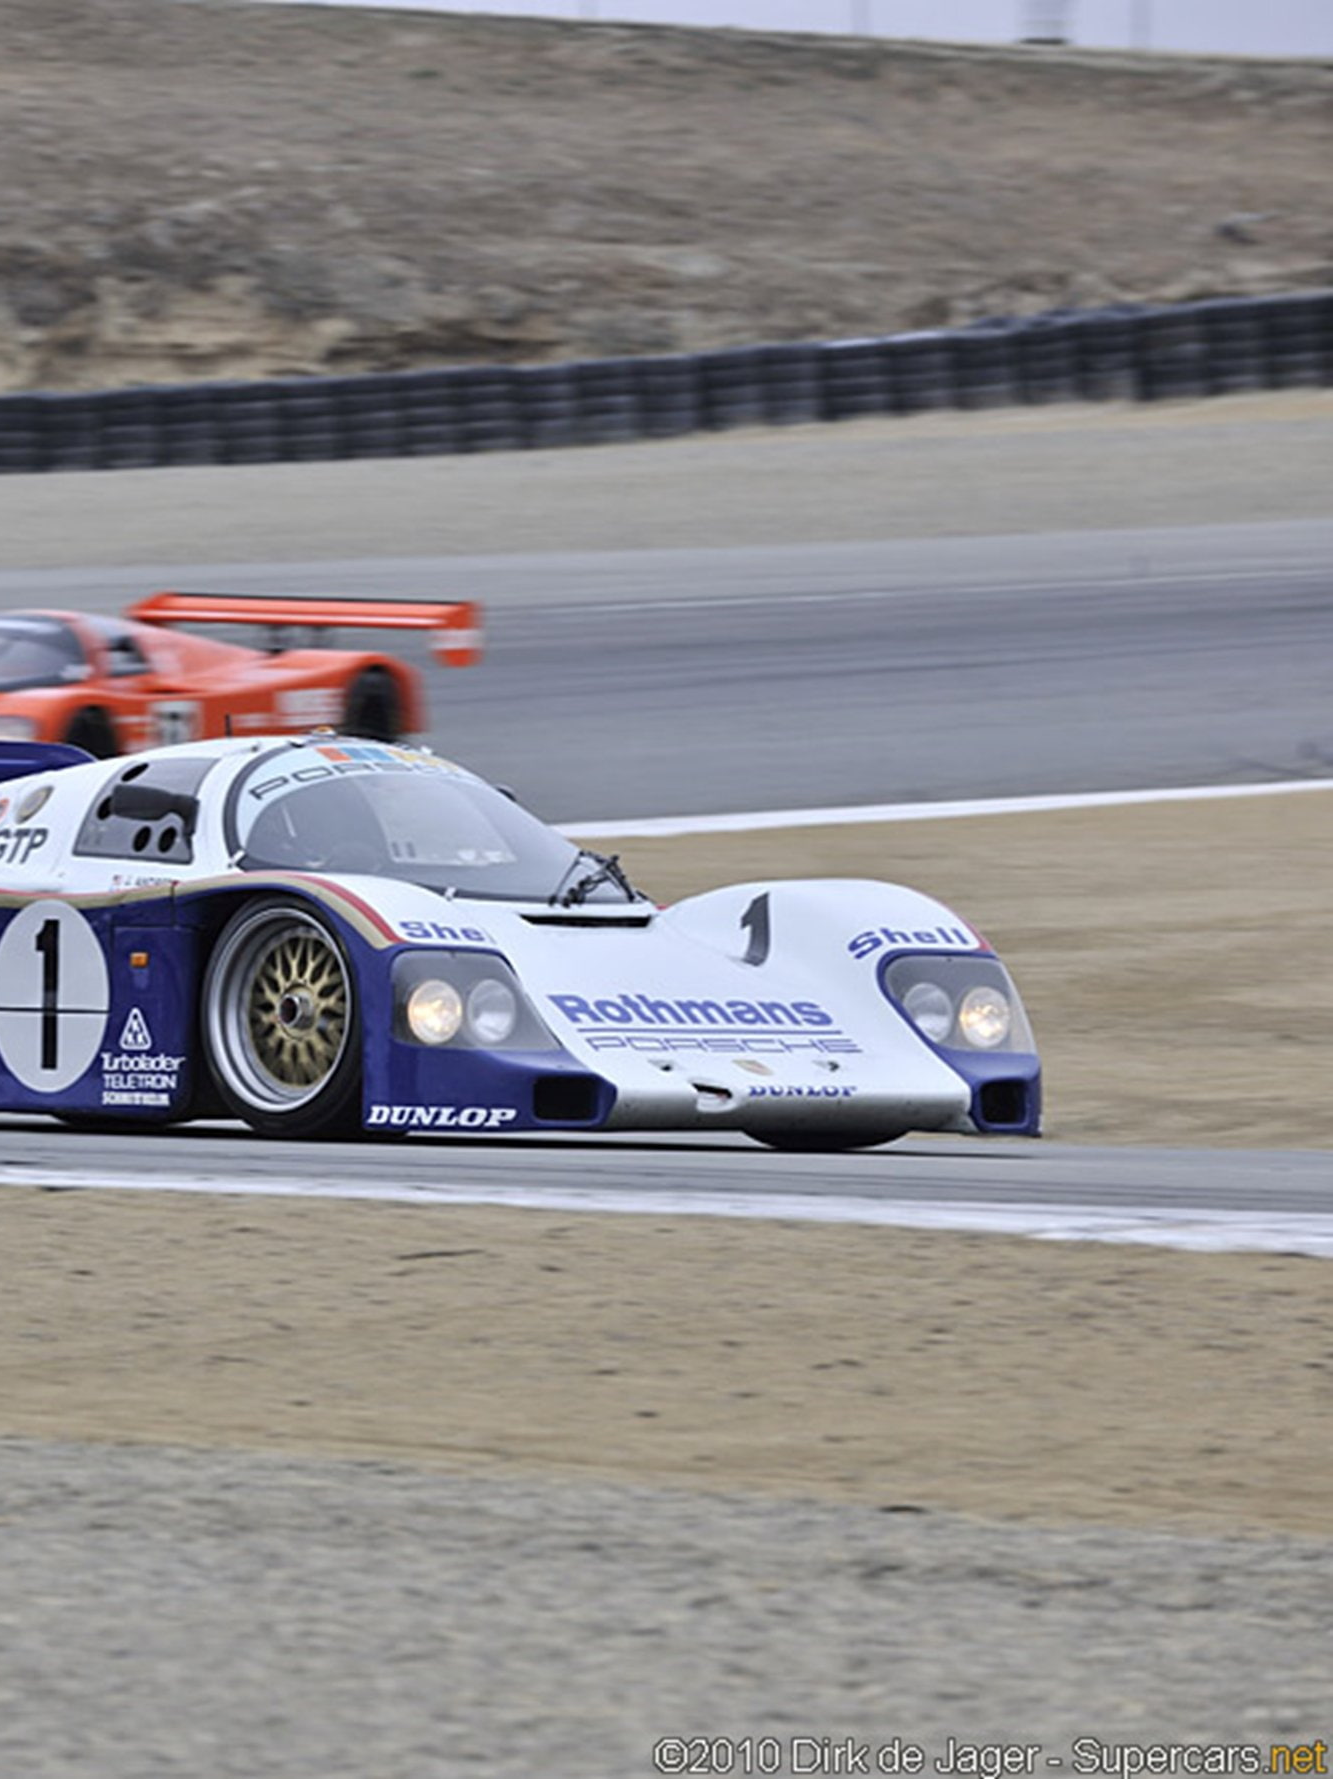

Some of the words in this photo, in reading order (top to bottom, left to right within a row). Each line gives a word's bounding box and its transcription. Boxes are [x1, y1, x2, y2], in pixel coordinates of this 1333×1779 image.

[248, 761, 466, 800] PORS
[740, 892, 771, 967] 1
[846, 926, 970, 960] Shell
[34, 918, 61, 1071] 1
[546, 992, 834, 1027] Rothmans
[584, 1036, 864, 1054] PORSCHE
[366, 1105, 517, 1128] DUNLOP
